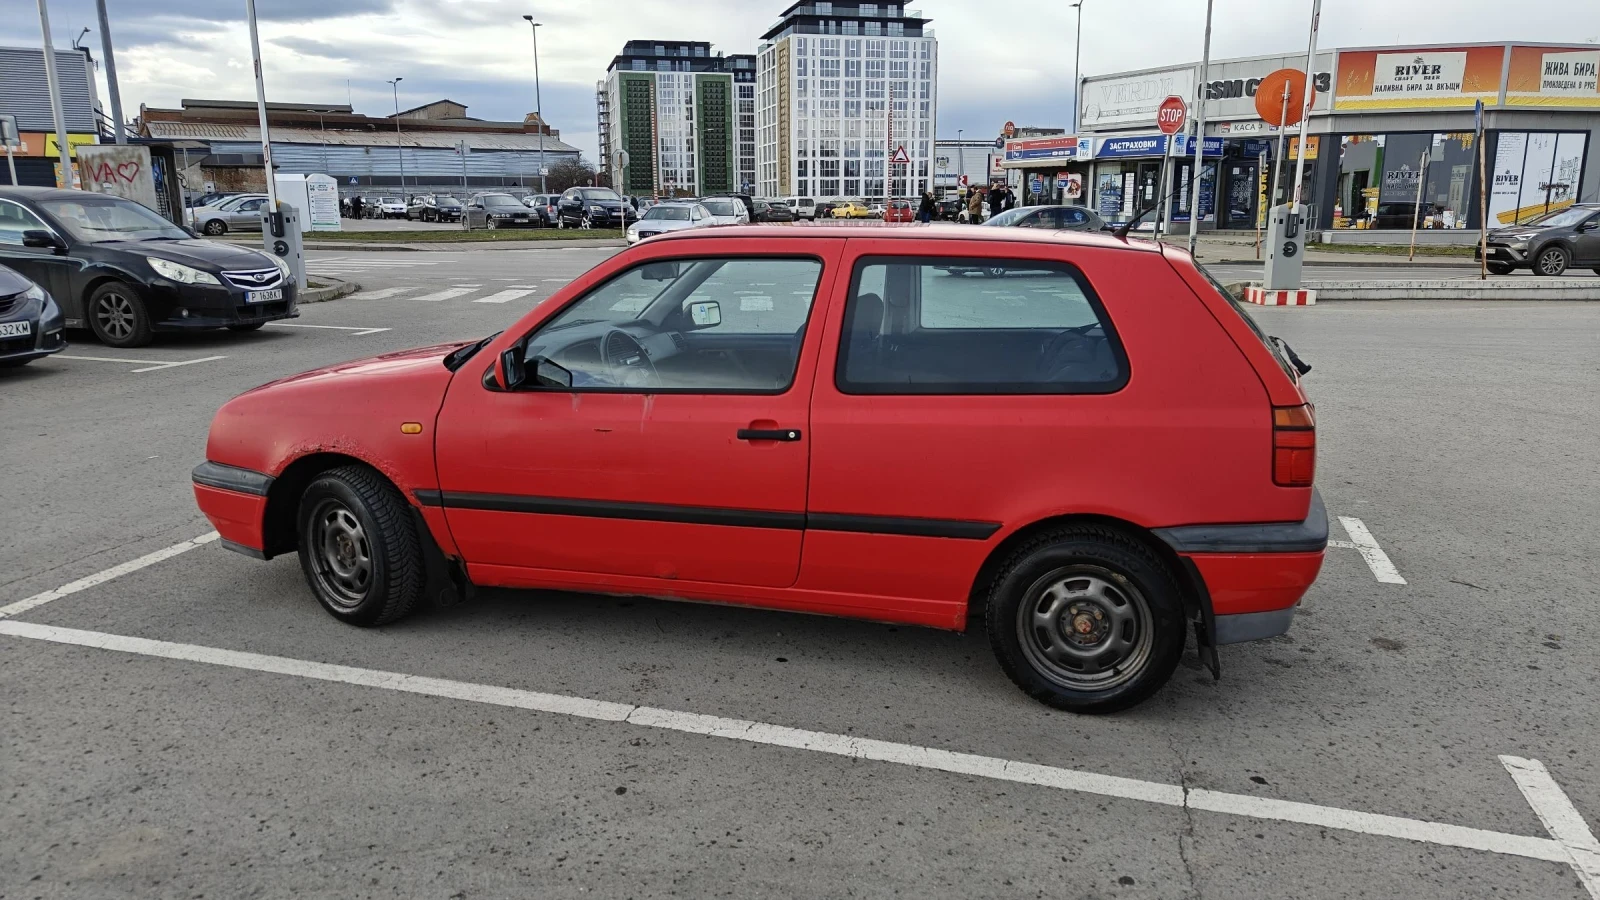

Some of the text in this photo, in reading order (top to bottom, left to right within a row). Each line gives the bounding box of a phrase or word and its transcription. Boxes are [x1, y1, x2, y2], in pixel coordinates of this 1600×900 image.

[1395, 64, 1441, 76] RIVER
[1544, 62, 1598, 78] ЖИВА БИРА,
[1374, 82, 1460, 93] НАЛИВНА БИРА ЗА ВКЪЩИ
[1160, 108, 1183, 122] STOP
[1110, 140, 1157, 150] ЗАСТРАХОВКИ
[1495, 174, 1519, 182] RIVER
